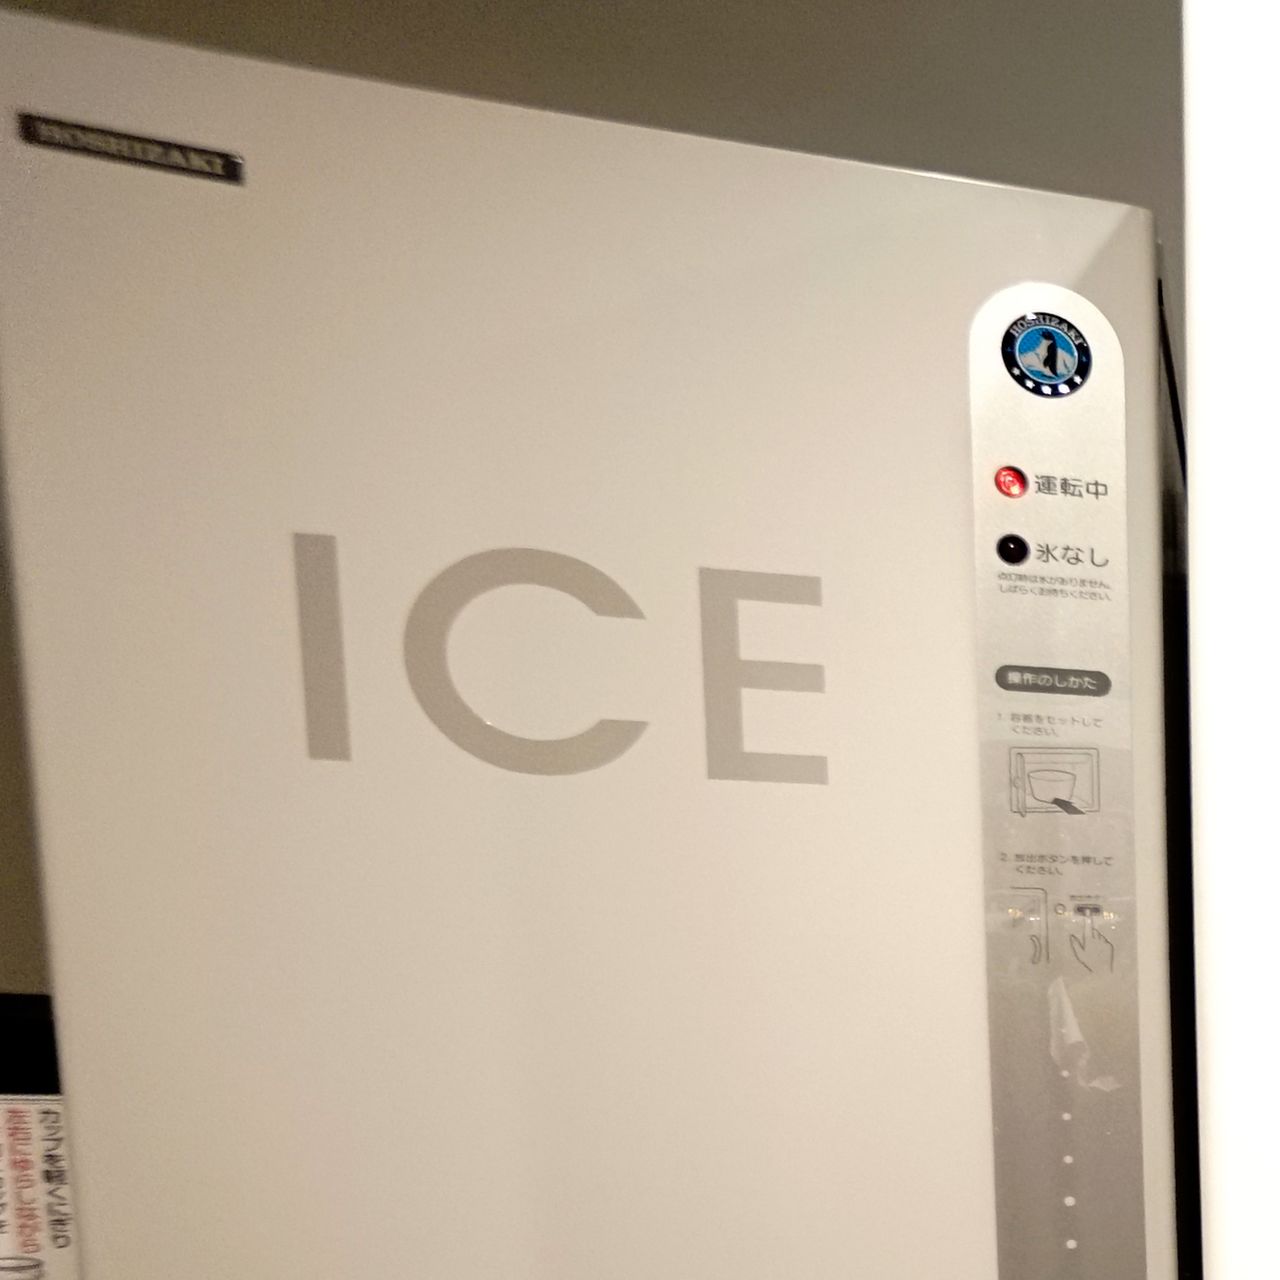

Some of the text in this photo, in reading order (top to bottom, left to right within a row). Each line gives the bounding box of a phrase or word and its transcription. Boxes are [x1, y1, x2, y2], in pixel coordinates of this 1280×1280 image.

[1010, 314, 1085, 349] HOSHIZAKI
[1034, 474, 1109, 500] 運転中
[1035, 543, 1110, 568] 氷なし
[293, 532, 829, 786] ICE
